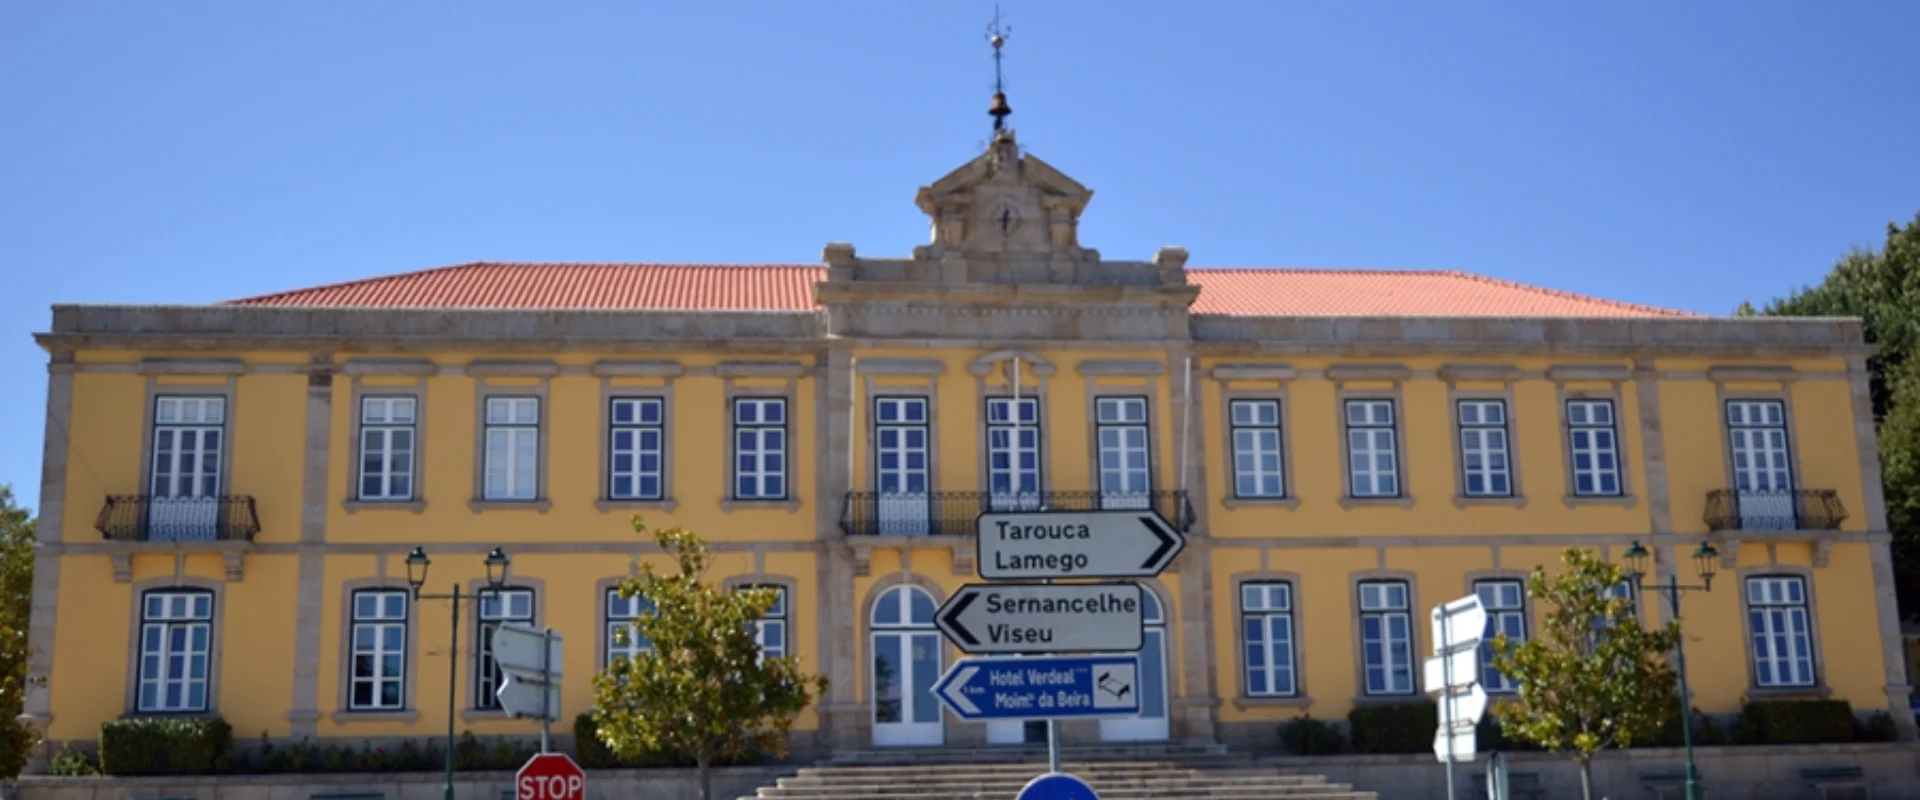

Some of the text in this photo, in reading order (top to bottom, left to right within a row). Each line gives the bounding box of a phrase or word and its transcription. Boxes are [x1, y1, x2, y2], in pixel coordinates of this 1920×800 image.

[995, 521, 1090, 540] Tarouca
[995, 551, 1088, 572] Lamego
[986, 593, 1137, 614] Sernancelhe
[986, 624, 1053, 644] Viseu
[990, 668, 1076, 686] Hotel Verdeal
[1038, 692, 1054, 707] da
[1058, 690, 1090, 707] Beira
[520, 775, 581, 800] STOP
